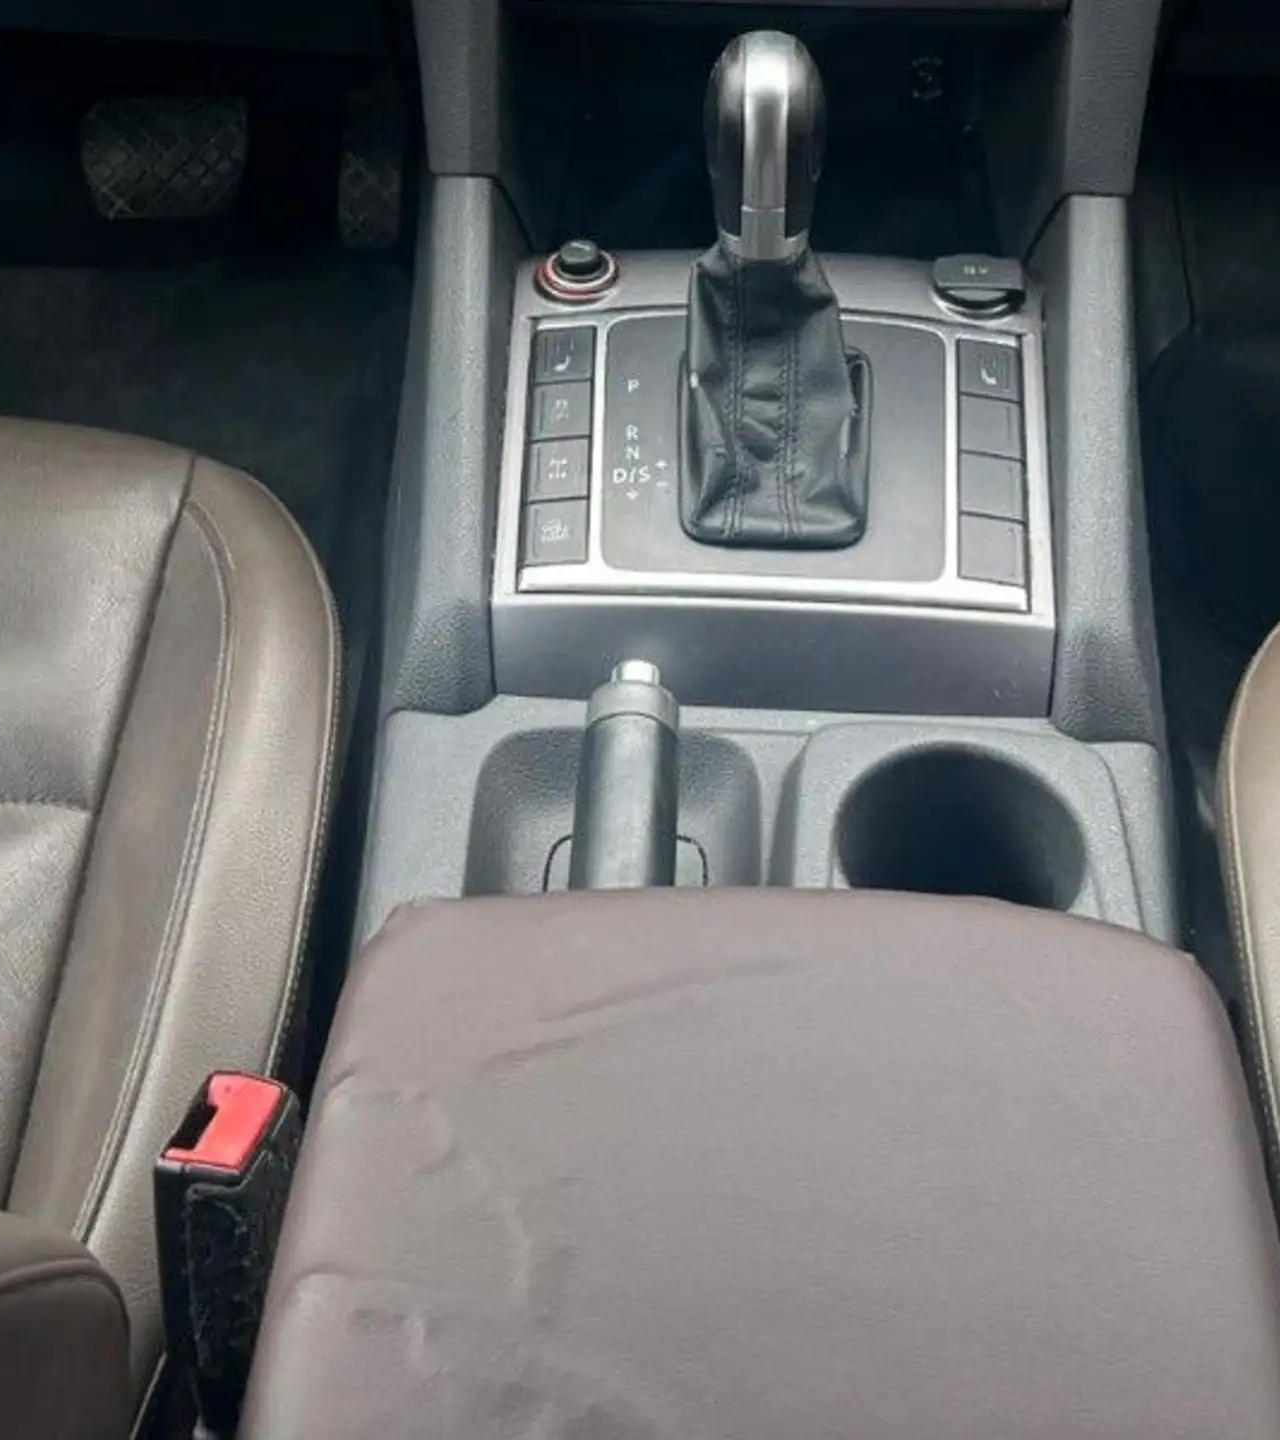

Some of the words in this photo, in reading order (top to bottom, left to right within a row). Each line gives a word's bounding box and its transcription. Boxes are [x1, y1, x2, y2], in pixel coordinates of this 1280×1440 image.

[627, 379, 640, 392] P
[626, 424, 639, 440] R
[626, 445, 640, 460] N
[612, 467, 651, 484] D/S
